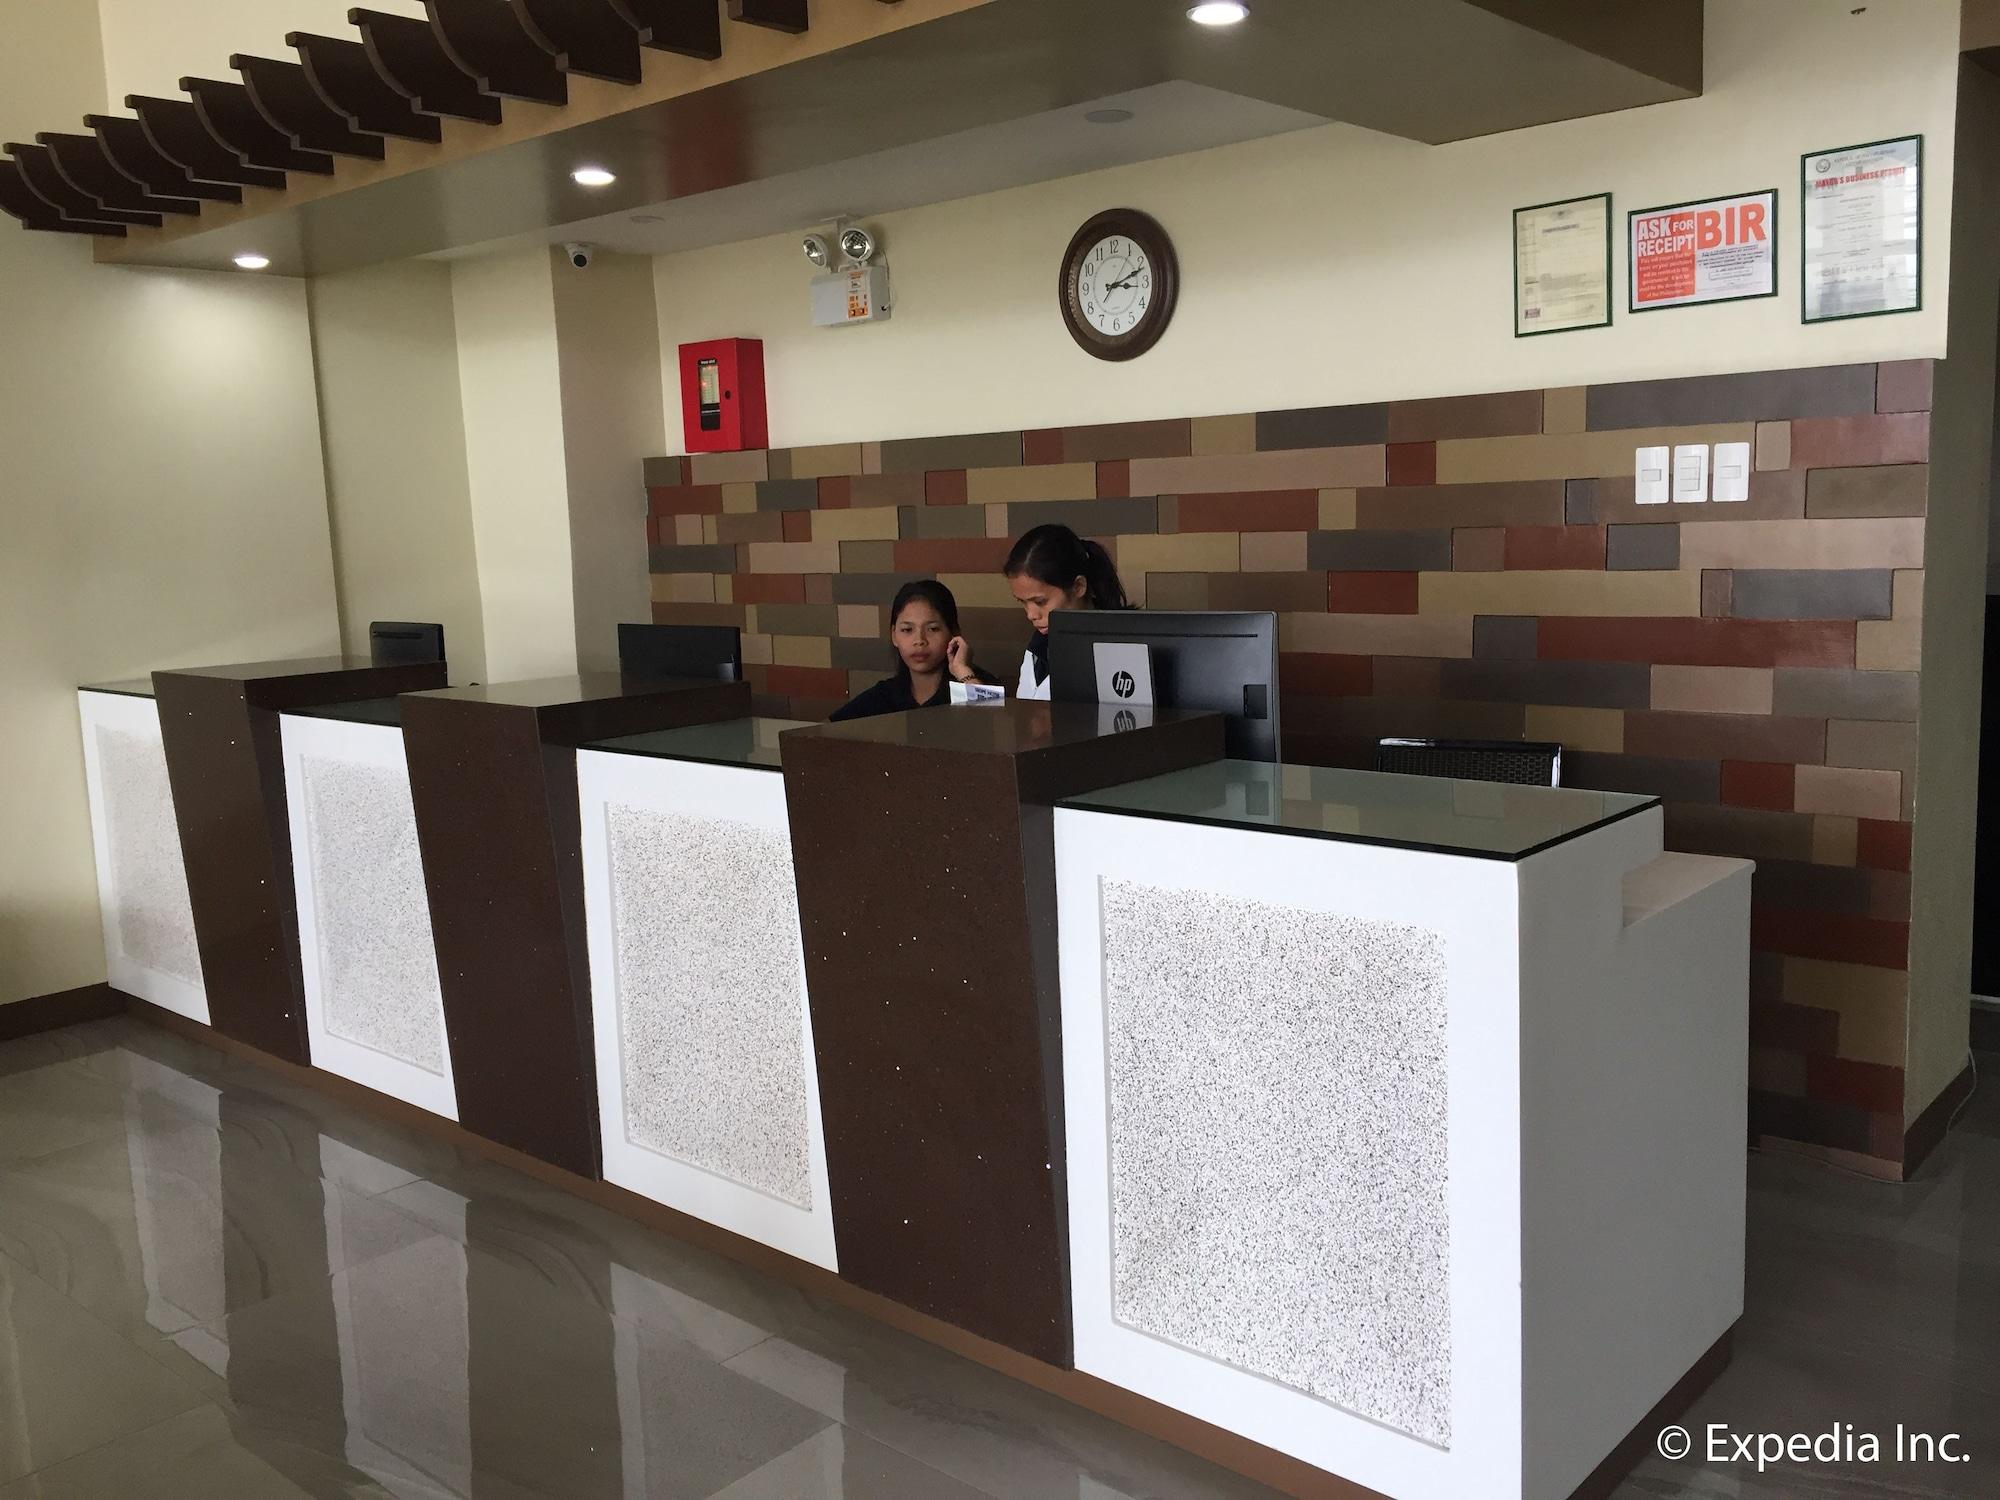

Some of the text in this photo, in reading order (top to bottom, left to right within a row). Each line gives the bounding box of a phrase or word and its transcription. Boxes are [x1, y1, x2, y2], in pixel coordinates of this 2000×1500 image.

[1846, 171, 1879, 183] BUSINESS
[1638, 217, 1694, 241] ASK FOR
[1697, 203, 1766, 249] BIR
[1110, 239, 1119, 254] 12
[1638, 234, 1695, 257] RECEIPT
[1095, 247, 1104, 261] 11
[1137, 256, 1145, 269] 2
[1084, 263, 1094, 277] 10
[1142, 275, 1149, 289] 3
[1082, 283, 1090, 296] 9
[1087, 302, 1094, 315] 8
[1138, 295, 1146, 309] 4
[1099, 314, 1105, 327] 7
[1113, 318, 1120, 331] 6
[1128, 312, 1135, 325] 5
[1114, 671, 1134, 698] hp
